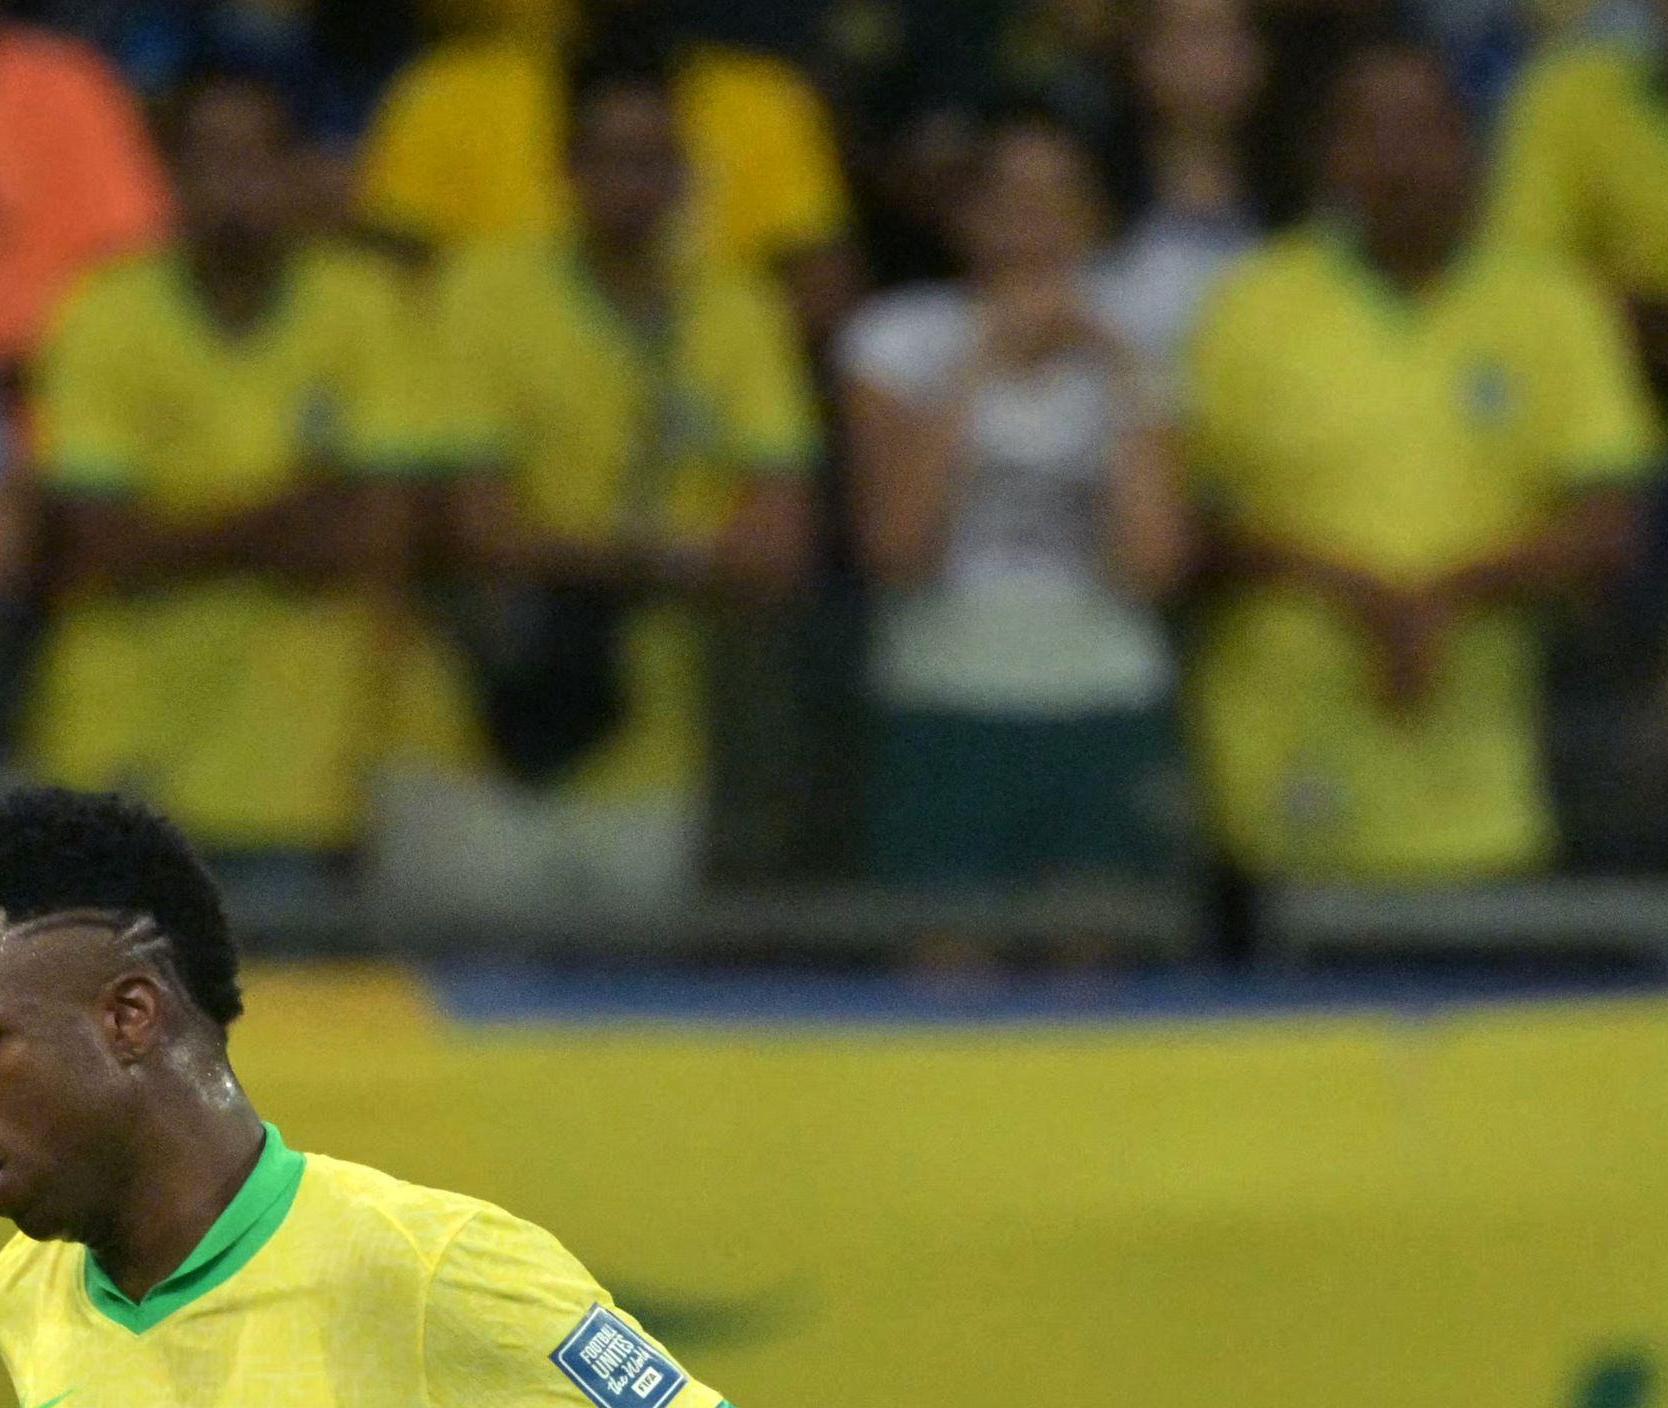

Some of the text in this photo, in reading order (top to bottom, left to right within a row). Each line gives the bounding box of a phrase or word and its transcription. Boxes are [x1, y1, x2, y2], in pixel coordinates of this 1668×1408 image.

[579, 1323, 617, 1365] FOOTBALL
[591, 1333, 634, 1379] UNITES
[607, 1375, 629, 1395] the
[637, 1373, 658, 1393] FIFA
